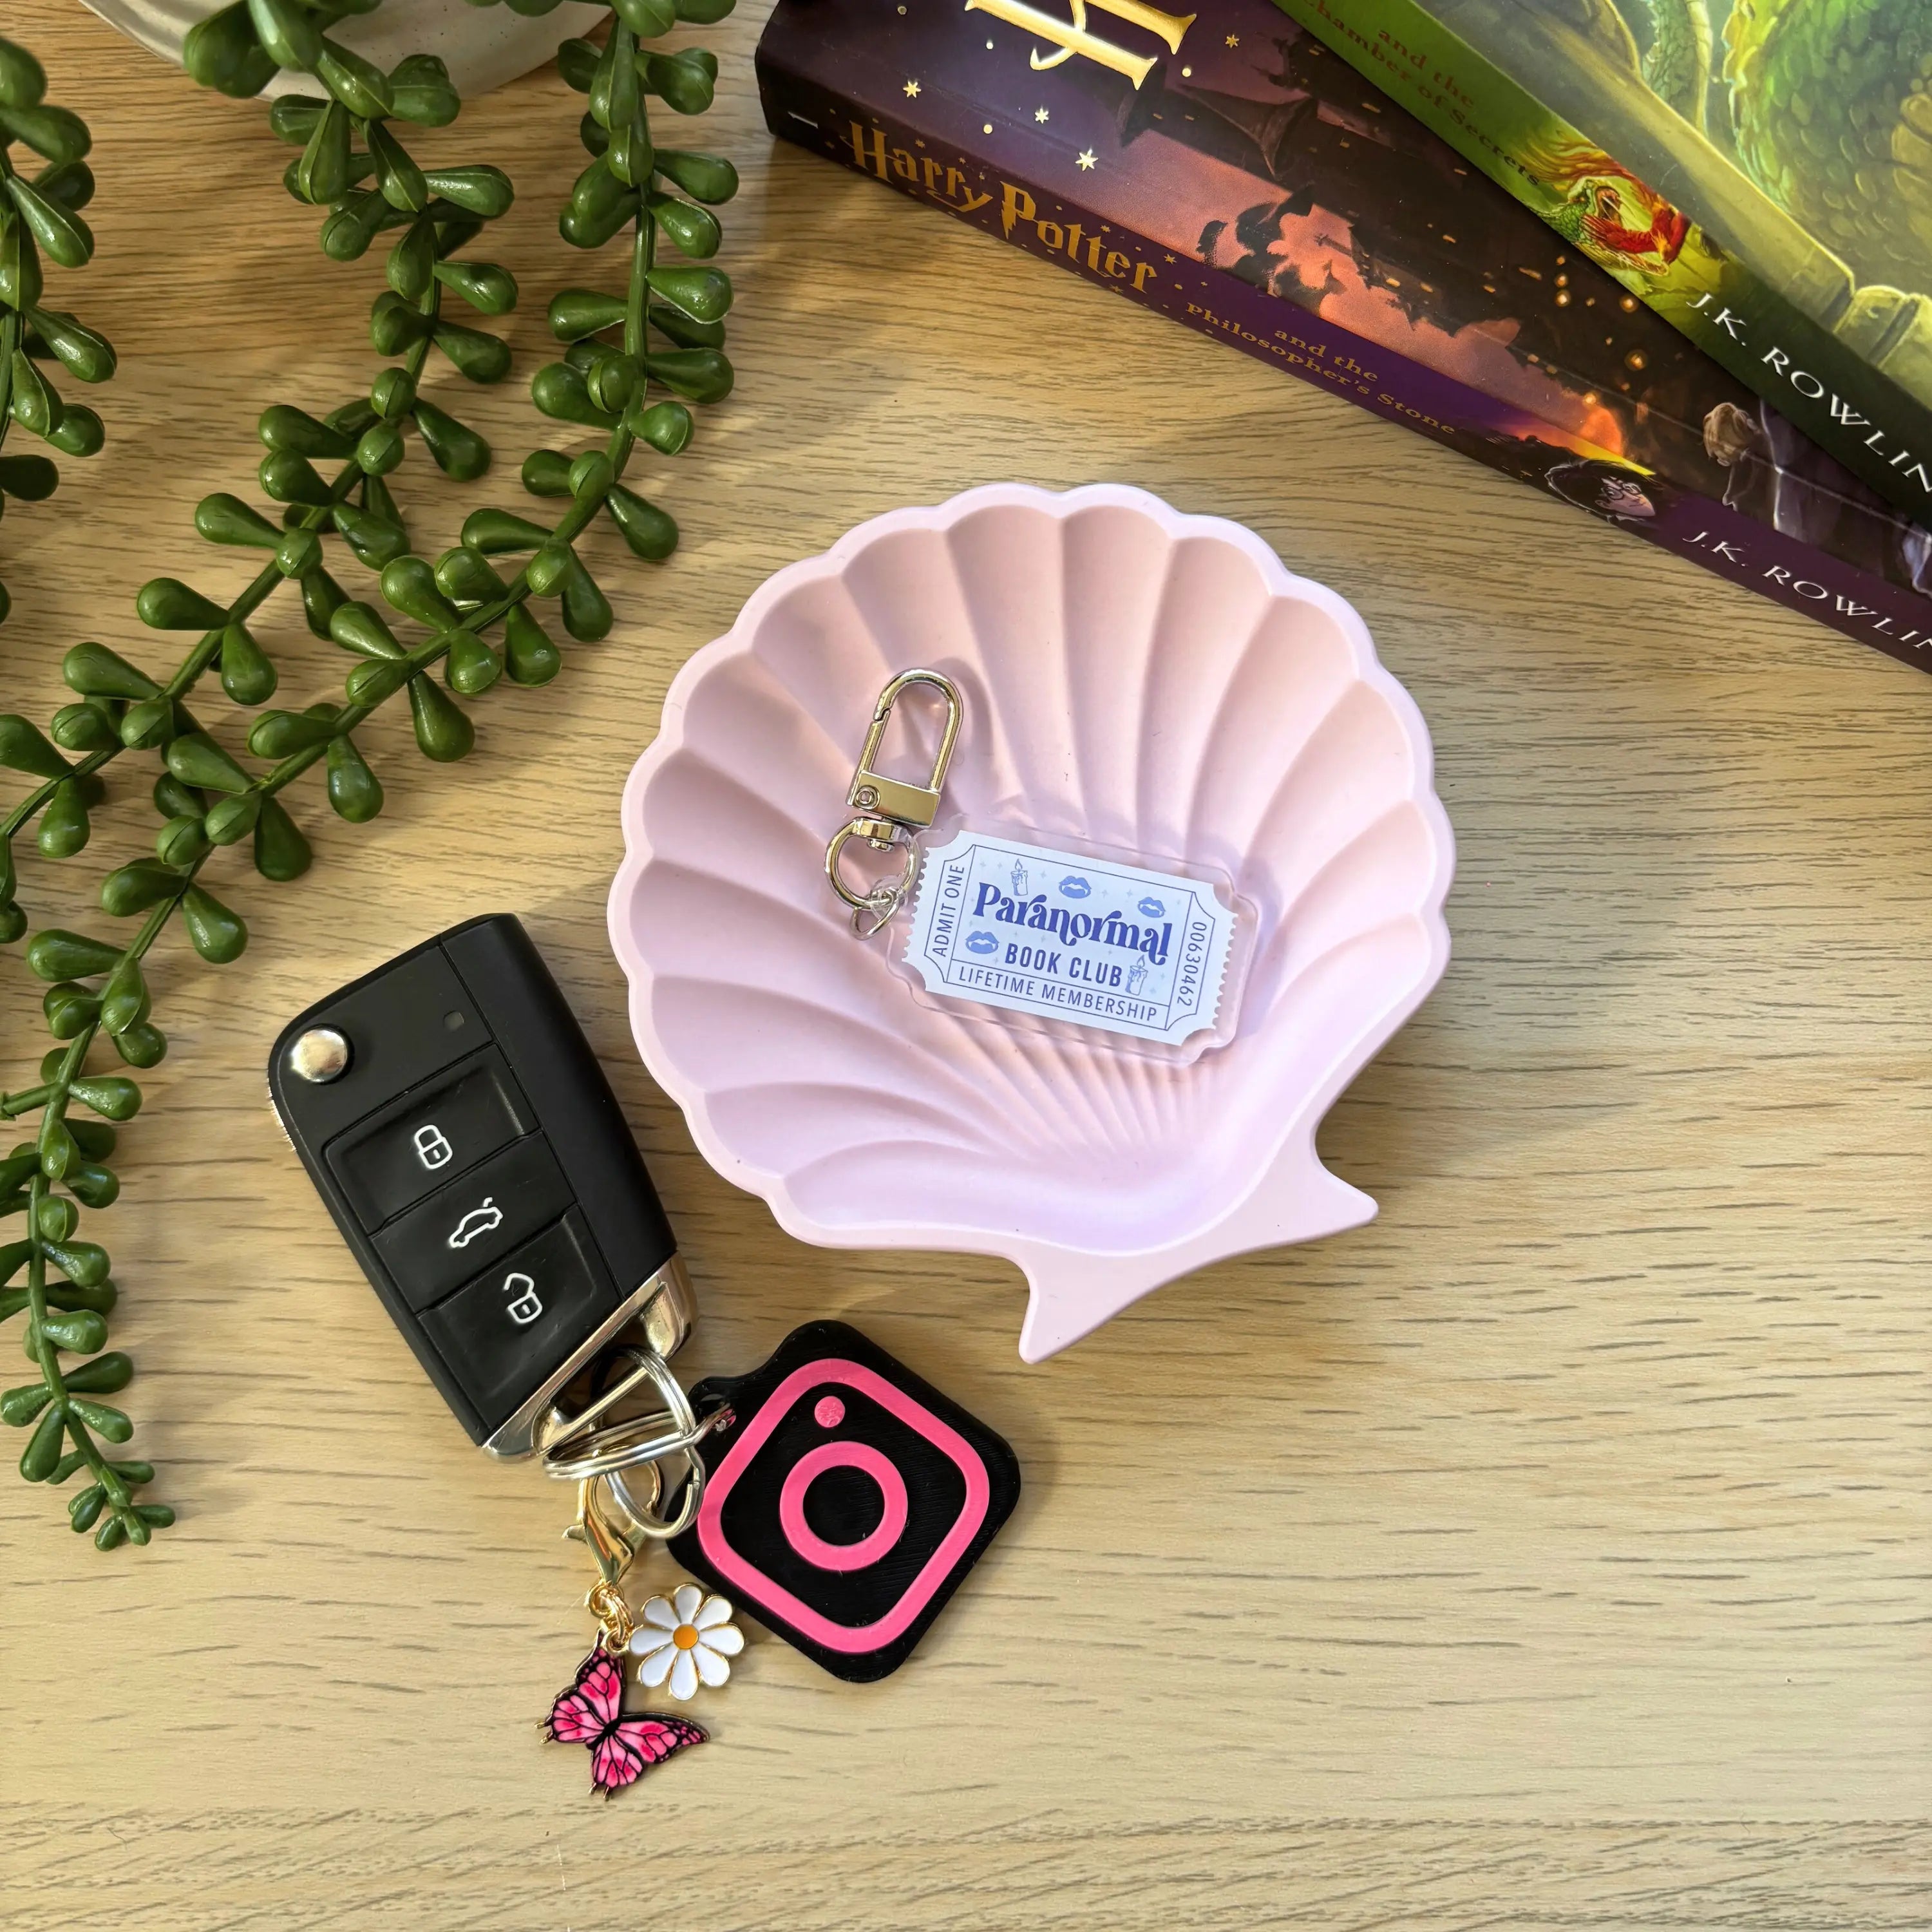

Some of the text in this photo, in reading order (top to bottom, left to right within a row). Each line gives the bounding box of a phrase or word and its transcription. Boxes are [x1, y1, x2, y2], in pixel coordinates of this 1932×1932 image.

[1305, 0, 1540, 185] hamber of Secrets
[1378, 30, 1473, 108] and the
[839, 120, 1157, 294] Harry Potter
[1186, 301, 1455, 435] Philosopher's Stone
[1274, 329, 1378, 382] and the
[1686, 292, 1932, 493] J.K. ROWLIN
[1682, 531, 1746, 567] J.K.
[932, 864, 965, 958] ADMIT ONE
[972, 882, 1173, 965] Paranormal
[958, 966, 1157, 1023] LIFETIME MEMBERSHIP
[1005, 943, 1122, 987] BOOK CLUB
[1177, 921, 1208, 1007] 00630462
